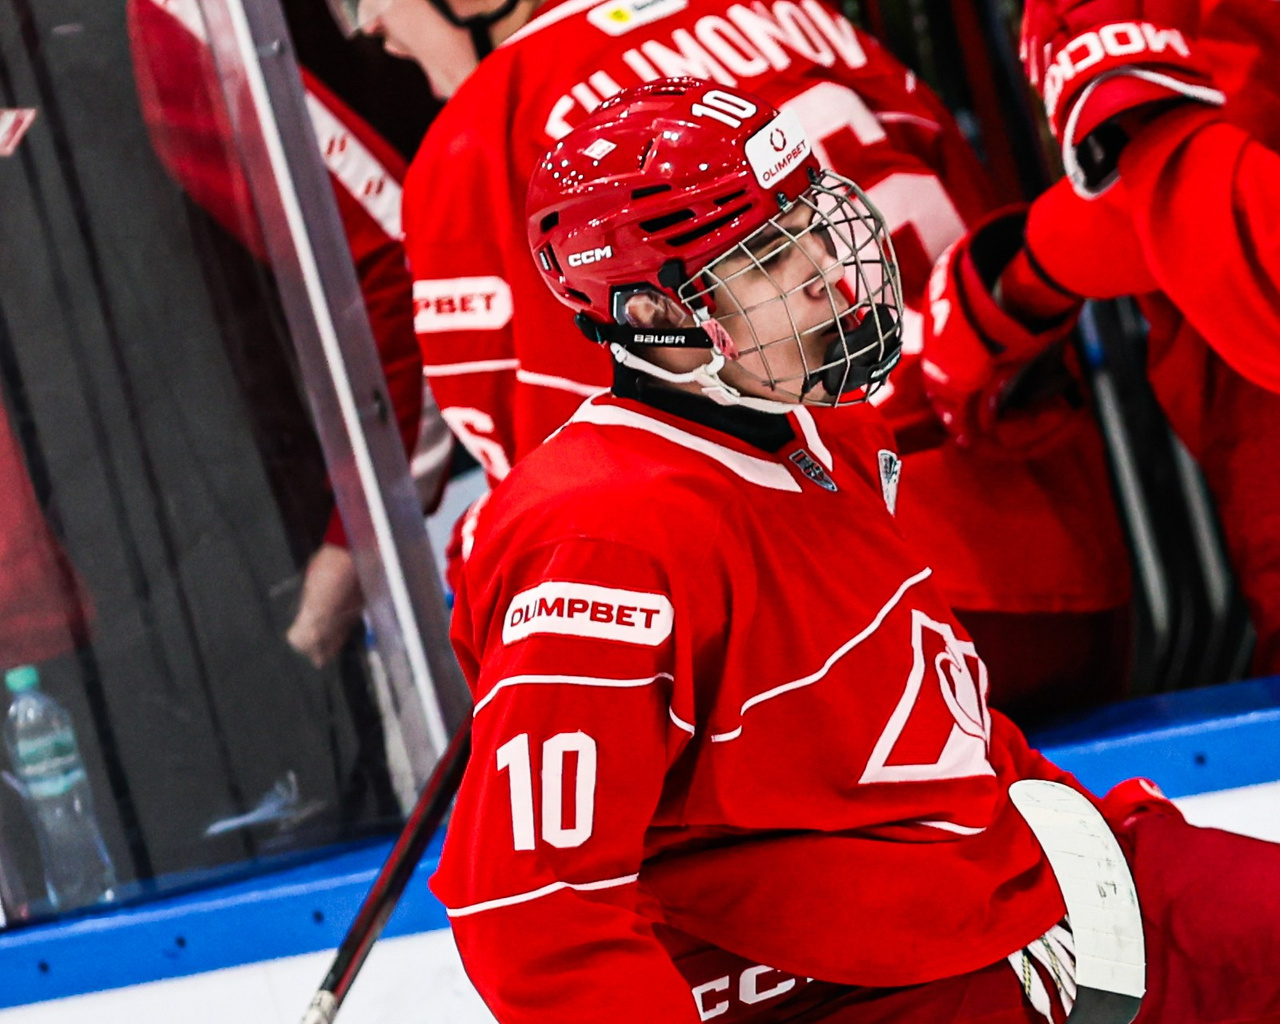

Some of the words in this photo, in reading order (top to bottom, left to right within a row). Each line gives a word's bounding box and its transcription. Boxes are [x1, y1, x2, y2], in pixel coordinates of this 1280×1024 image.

[1043, 21, 1191, 136] МОСК
[691, 89, 759, 129] 10
[762, 138, 808, 184] OLIMPBET
[568, 245, 613, 268] CCM
[633, 332, 686, 345] BAUER
[496, 730, 597, 851] 10
[691, 964, 815, 1023] CC
